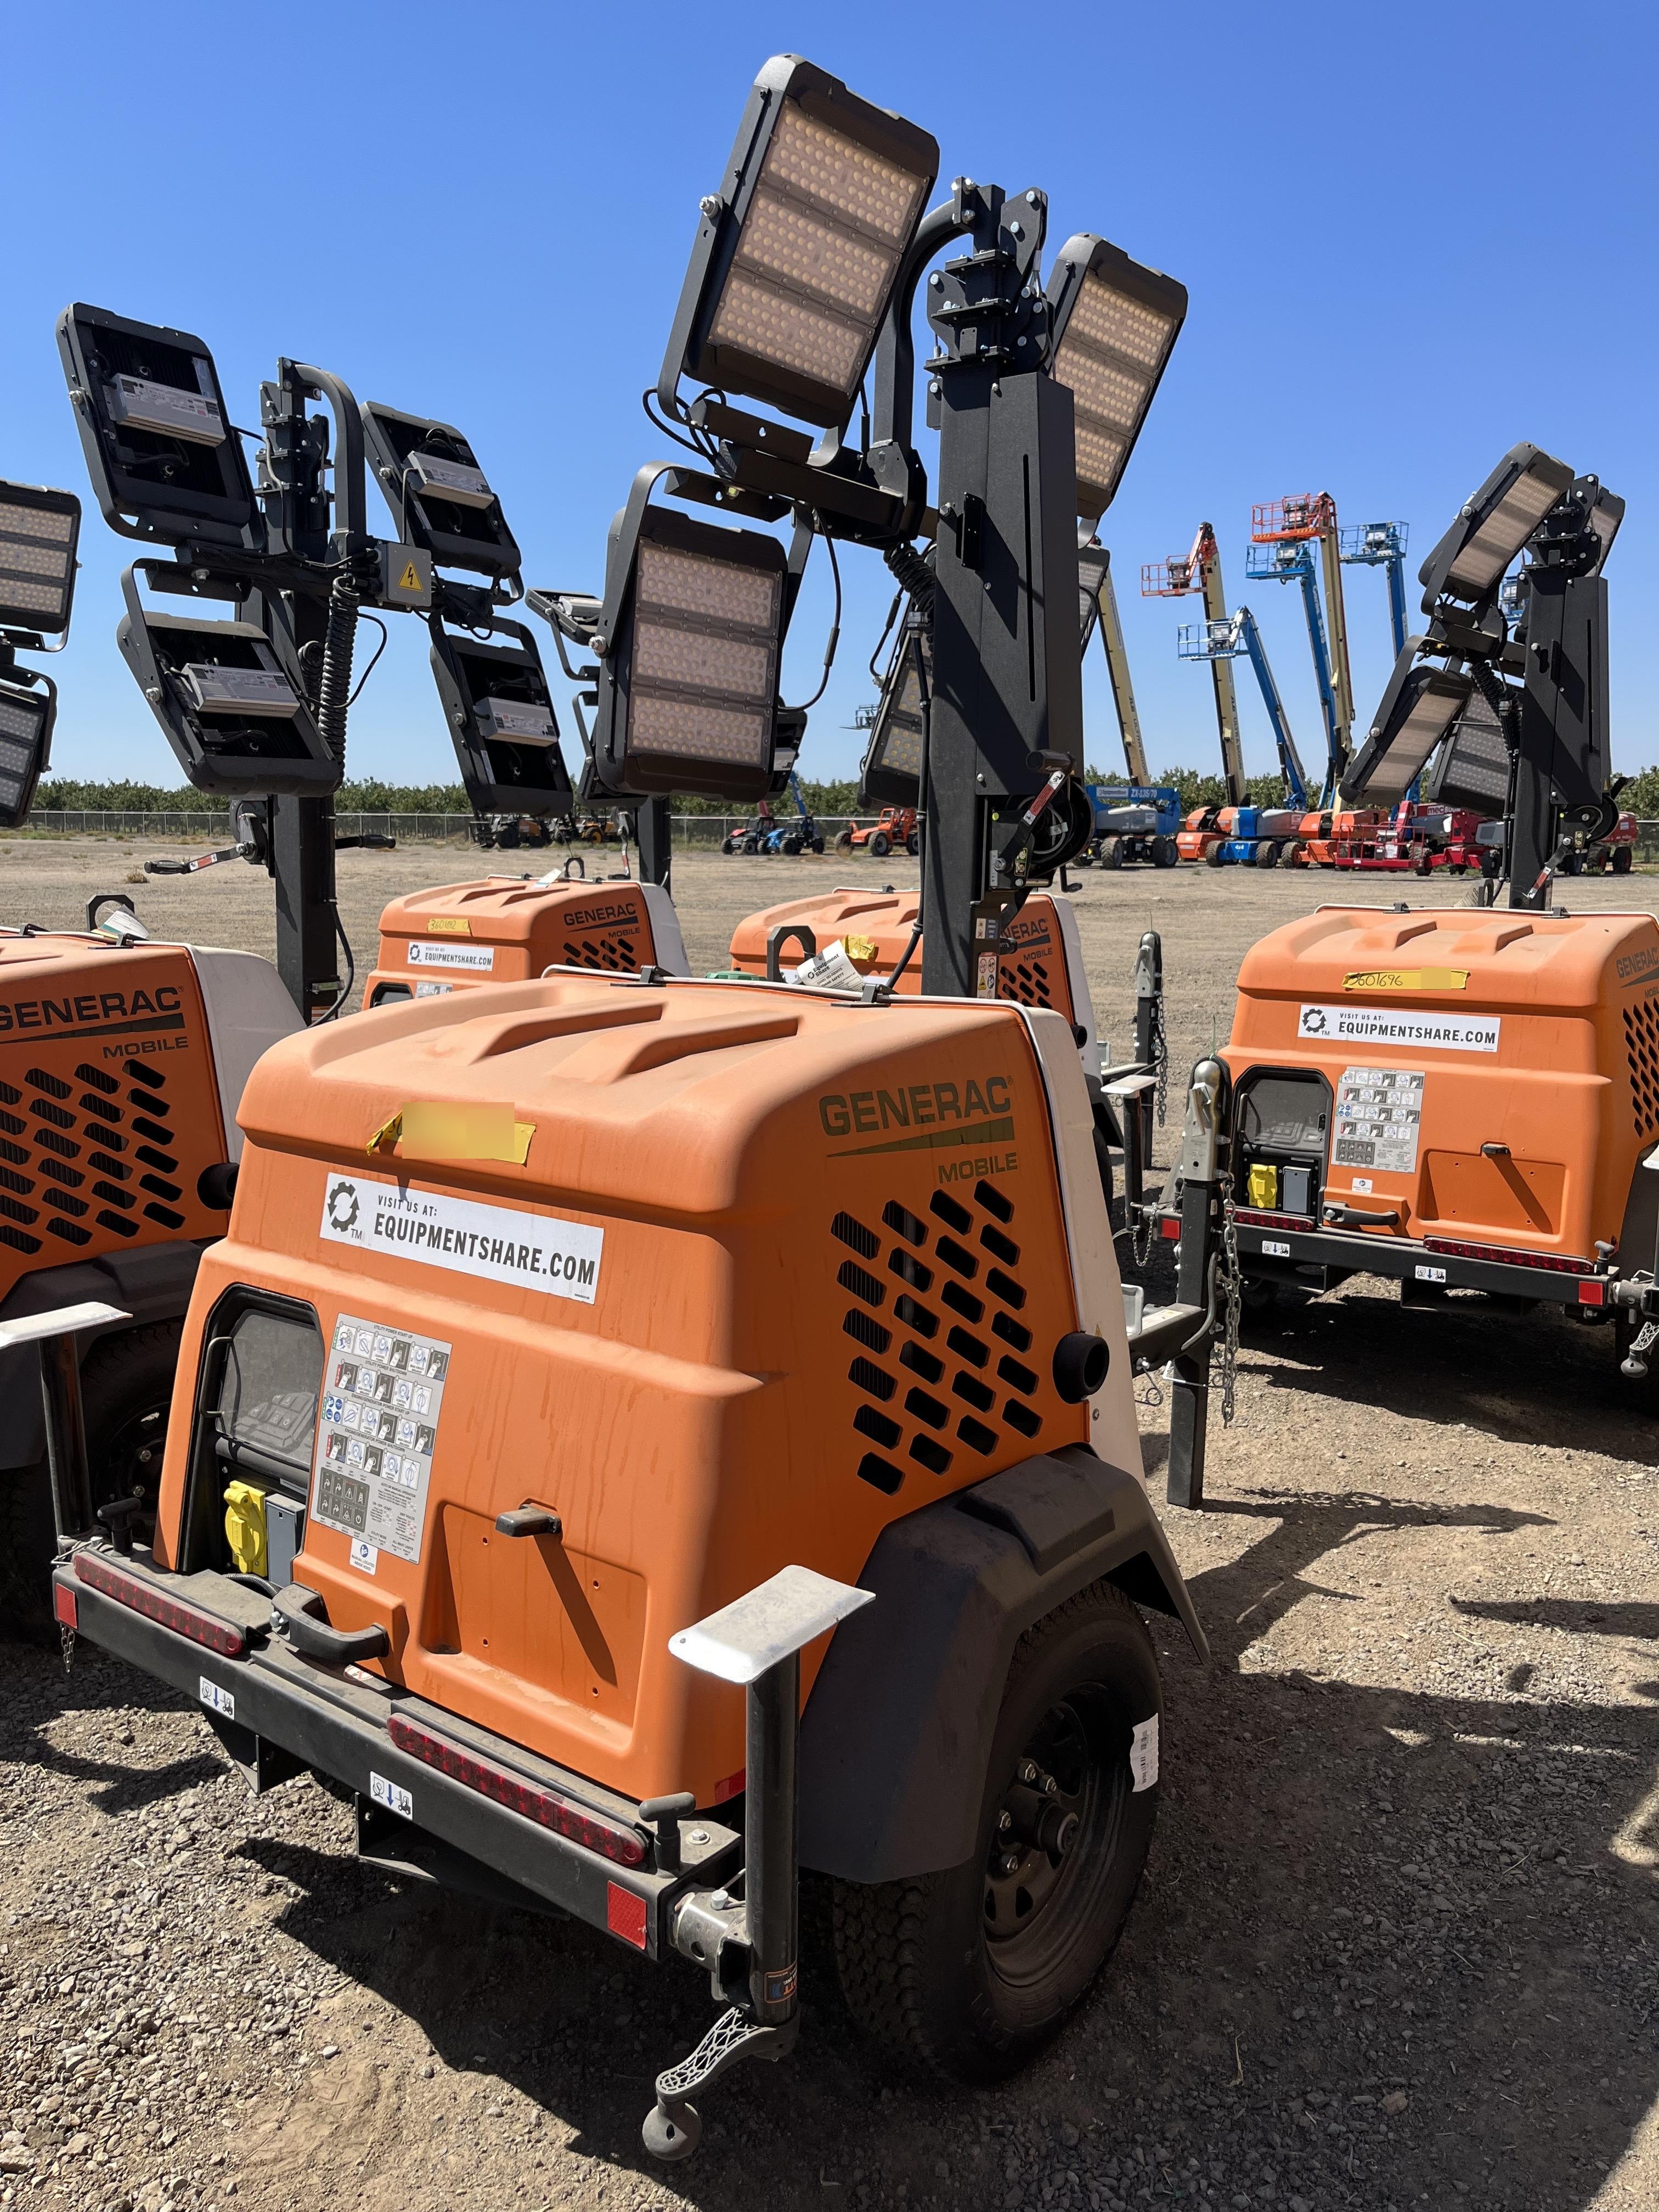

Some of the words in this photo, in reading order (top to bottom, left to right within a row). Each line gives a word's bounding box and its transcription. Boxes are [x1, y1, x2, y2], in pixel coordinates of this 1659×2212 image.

[1133, 718, 1142, 749] ULTRA
[1138, 749, 1147, 776] BOOM
[1428, 806, 1444, 815] mec
[563, 903, 636, 926] GENERAC
[608, 927, 641, 939] MOBILE
[425, 952, 492, 966] EQUIPMENTSHARE.COM
[813, 953, 839, 973] Equipment
[1023, 947, 1053, 962] MOBILE
[1616, 947, 1658, 979] GENERAC
[815, 966, 830, 977] Share
[1339, 1022, 1496, 1044] EQUIPMENTSHARE.COM
[103, 1036, 189, 1059] MOBILE
[819, 1076, 1011, 1136] GENERAC
[938, 1152, 1018, 1184] MOBILE
[377, 1195, 403, 1210] VISIT
[406, 1201, 418, 1214] US
[422, 1205, 438, 1217] AT:
[351, 1228, 363, 1239] TM
[374, 1212, 595, 1285] EQUIPMENTSHARE.COM
[389, 1367, 407, 1376] SHUTDOWN
[375, 1438, 387, 1447] POWER
[387, 1443, 405, 1453] SHUTDOWN
